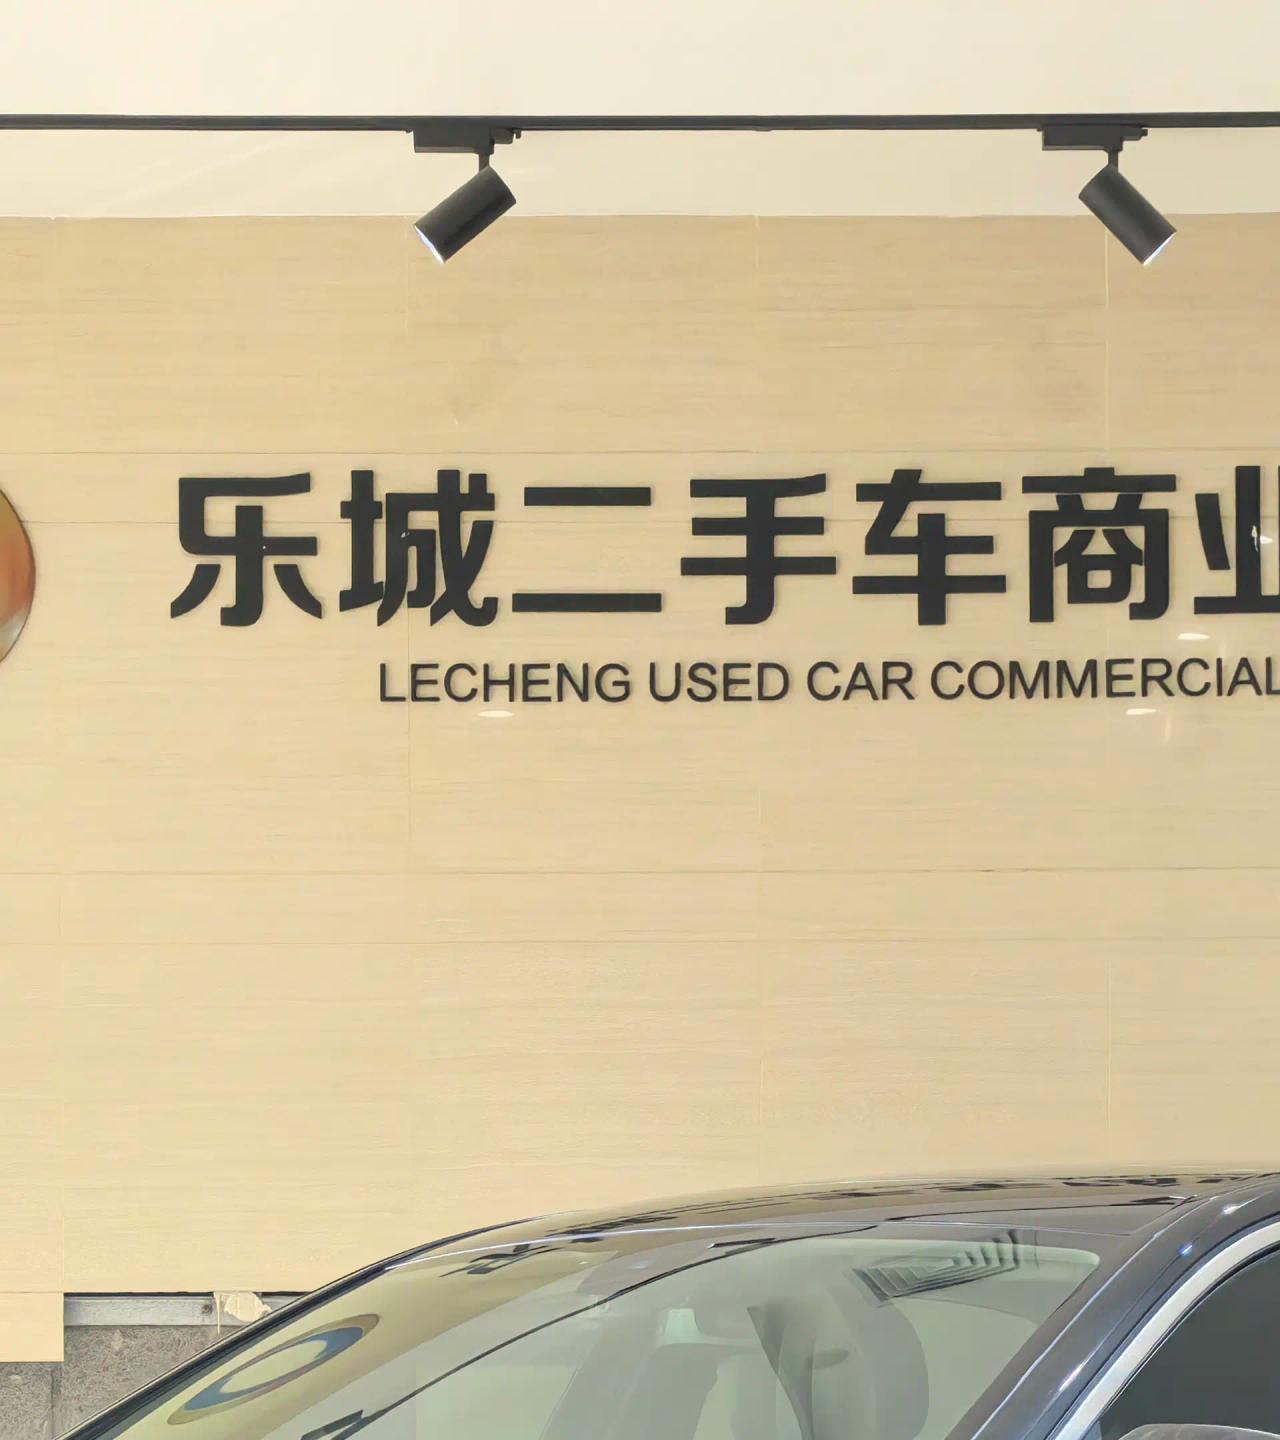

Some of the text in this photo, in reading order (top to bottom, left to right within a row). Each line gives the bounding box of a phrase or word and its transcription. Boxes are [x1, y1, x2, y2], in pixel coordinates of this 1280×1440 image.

[378, 662, 631, 703] LECHENG
[649, 662, 790, 703] USED
[806, 661, 915, 702] CAR
